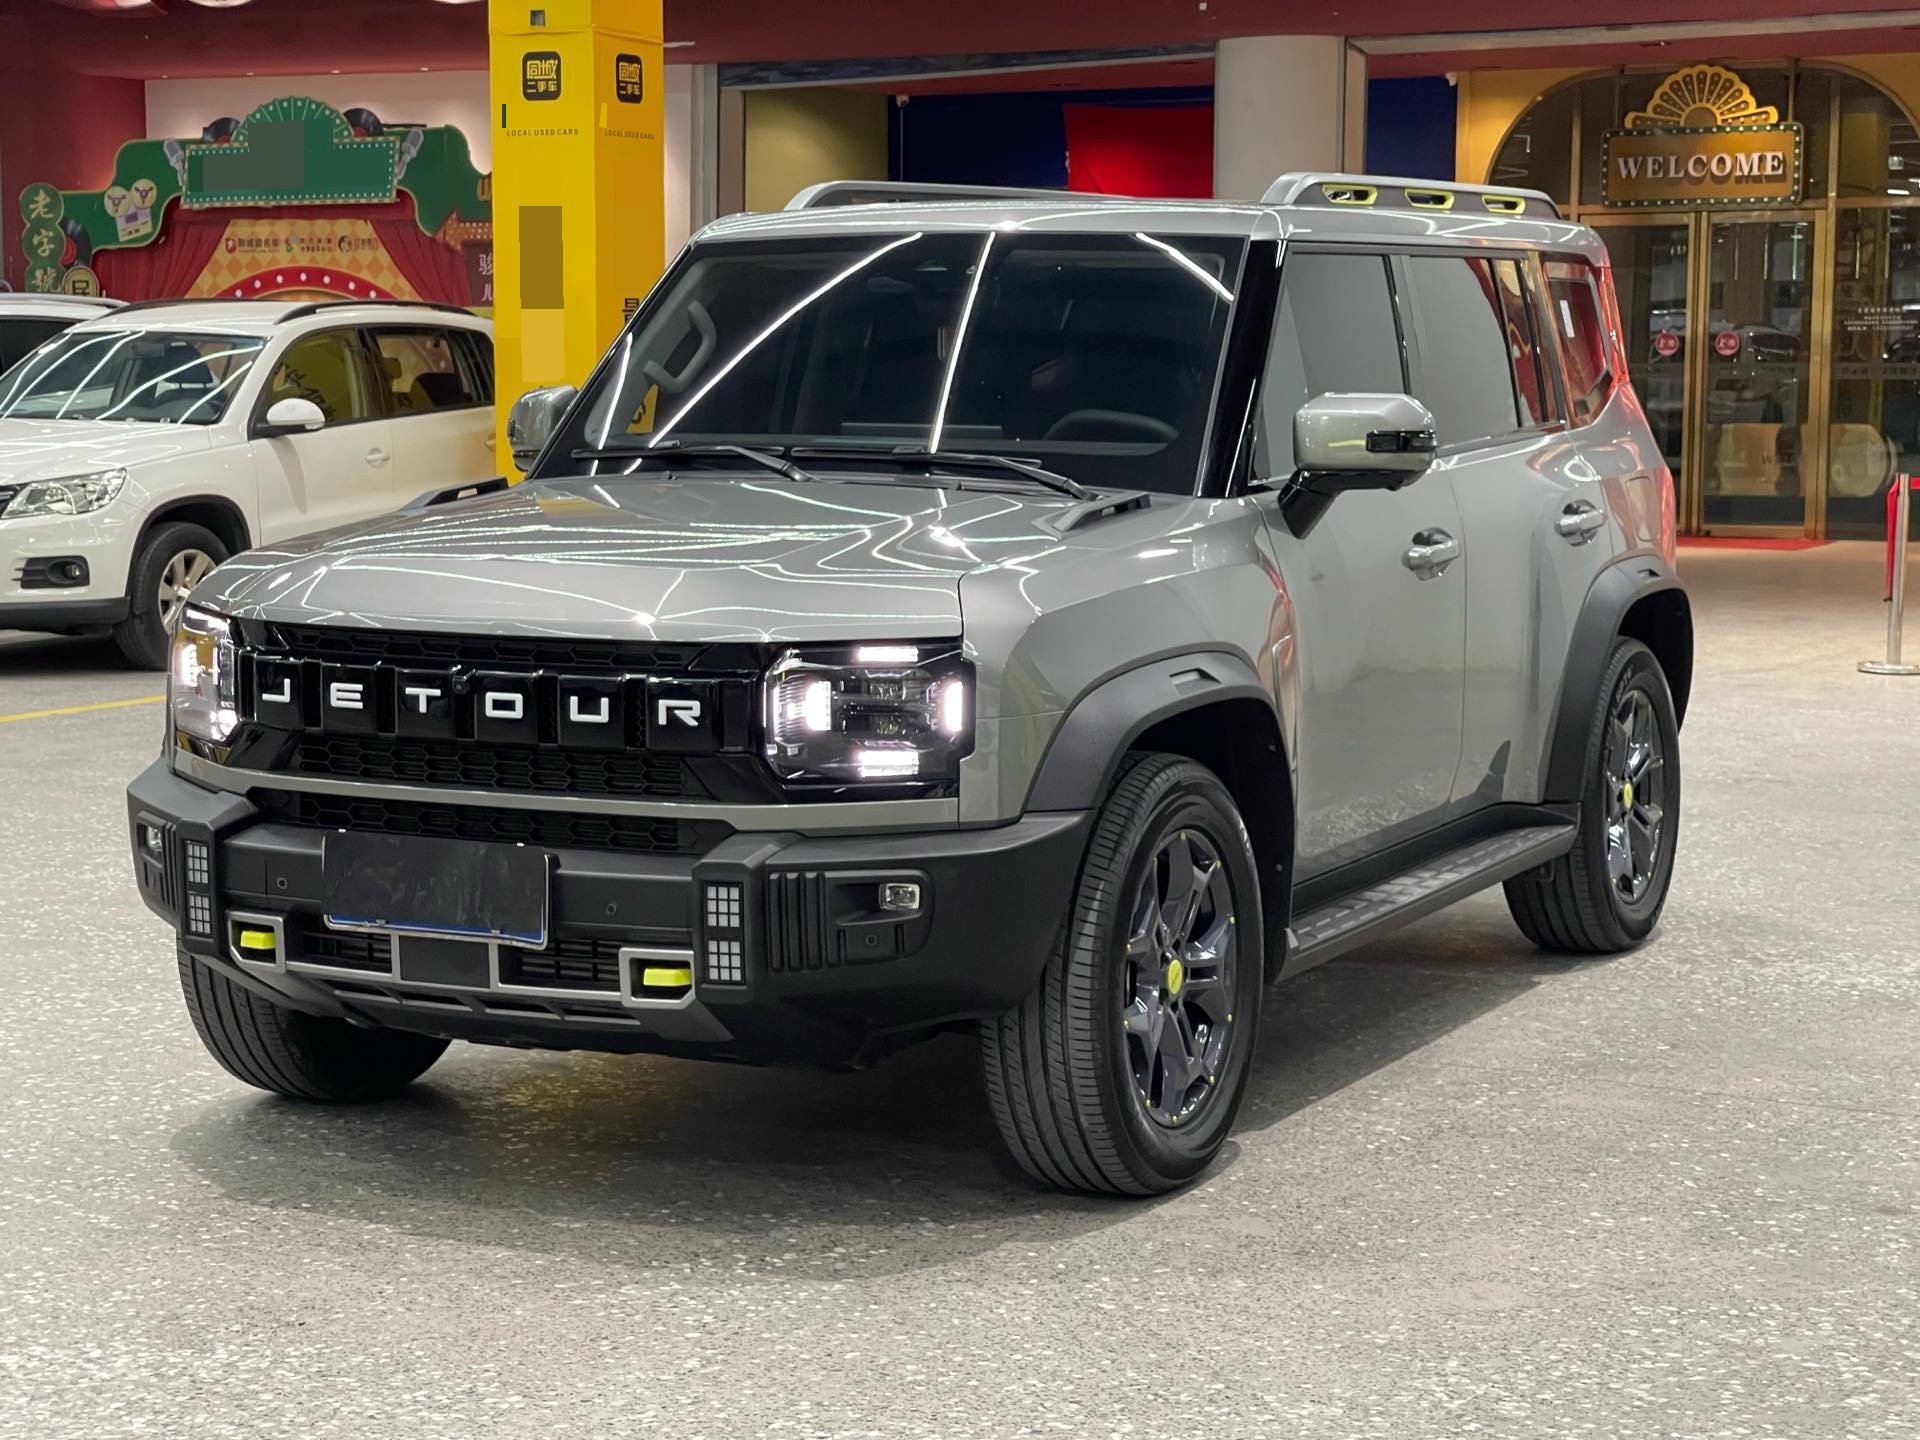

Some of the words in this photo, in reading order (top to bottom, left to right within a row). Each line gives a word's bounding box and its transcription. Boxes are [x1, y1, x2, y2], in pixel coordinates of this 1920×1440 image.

[526, 59, 559, 80] 同城
[619, 61, 641, 83] 同城
[526, 81, 558, 93] 二手车
[619, 82, 641, 95] 二手车
[506, 129, 532, 137] LOCAL
[533, 129, 555, 137] USED
[557, 128, 579, 136] CARS
[604, 129, 623, 137] LOCAL
[624, 130, 639, 139] USED
[639, 132, 655, 140] CARS
[1616, 151, 1784, 180] WELCOME
[262, 678, 702, 727] JETOUR
